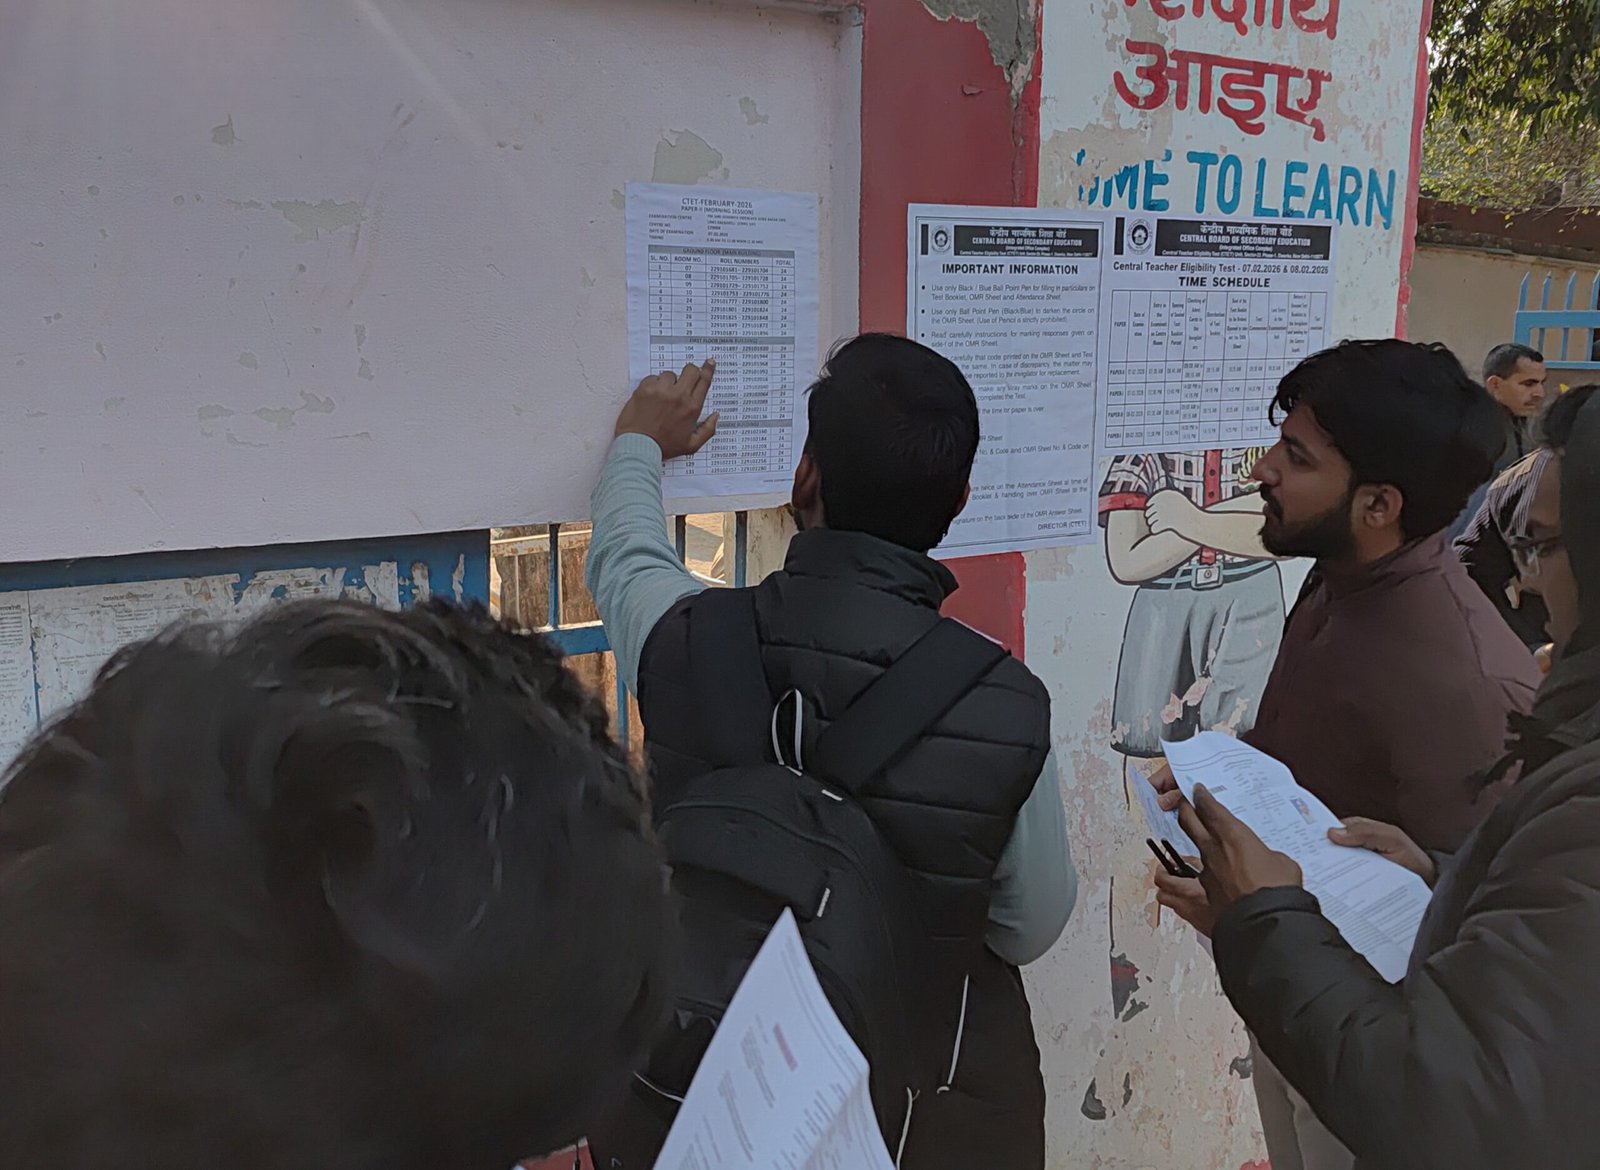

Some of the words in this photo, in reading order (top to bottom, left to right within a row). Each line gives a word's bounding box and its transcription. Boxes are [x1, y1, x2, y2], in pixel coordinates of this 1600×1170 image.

[1113, 38, 1332, 142] आइए
[1186, 151, 1242, 215] TO
[1252, 156, 1397, 230] LEARN
[682, 198, 753, 209] CTET-FEBRUARY-2026
[972, 237, 995, 245] CENTRAL
[1024, 238, 1053, 246] SECONDARY
[1180, 234, 1207, 243] CENTRAL
[1209, 235, 1229, 244] BOARD
[1231, 236, 1238, 244] OF
[1240, 236, 1276, 245] SECONDARY
[1277, 238, 1311, 246] EDUCATION
[942, 263, 1004, 274] IMPORTANT
[1010, 264, 1078, 275] INFORMATION
[1114, 261, 1143, 271] Central
[1145, 262, 1178, 272] Teacher
[1180, 263, 1216, 274] Eligibility
[1218, 264, 1235, 273] Test
[1242, 264, 1280, 274] 07.02.2026
[1282, 265, 1288, 274] &
[1290, 265, 1328, 274] 08.02.2026
[1179, 276, 1207, 287] TIME
[1213, 277, 1270, 288] SCHEDULE
[945, 285, 957, 293] only
[1041, 285, 1054, 293] filling
[945, 308, 957, 316] only
[949, 332, 972, 340] carefully
[1020, 330, 1040, 338] marking
[1070, 330, 1085, 338] given
[1038, 522, 1068, 530] DIRECTOR
[1070, 520, 1087, 528] (CTET)
